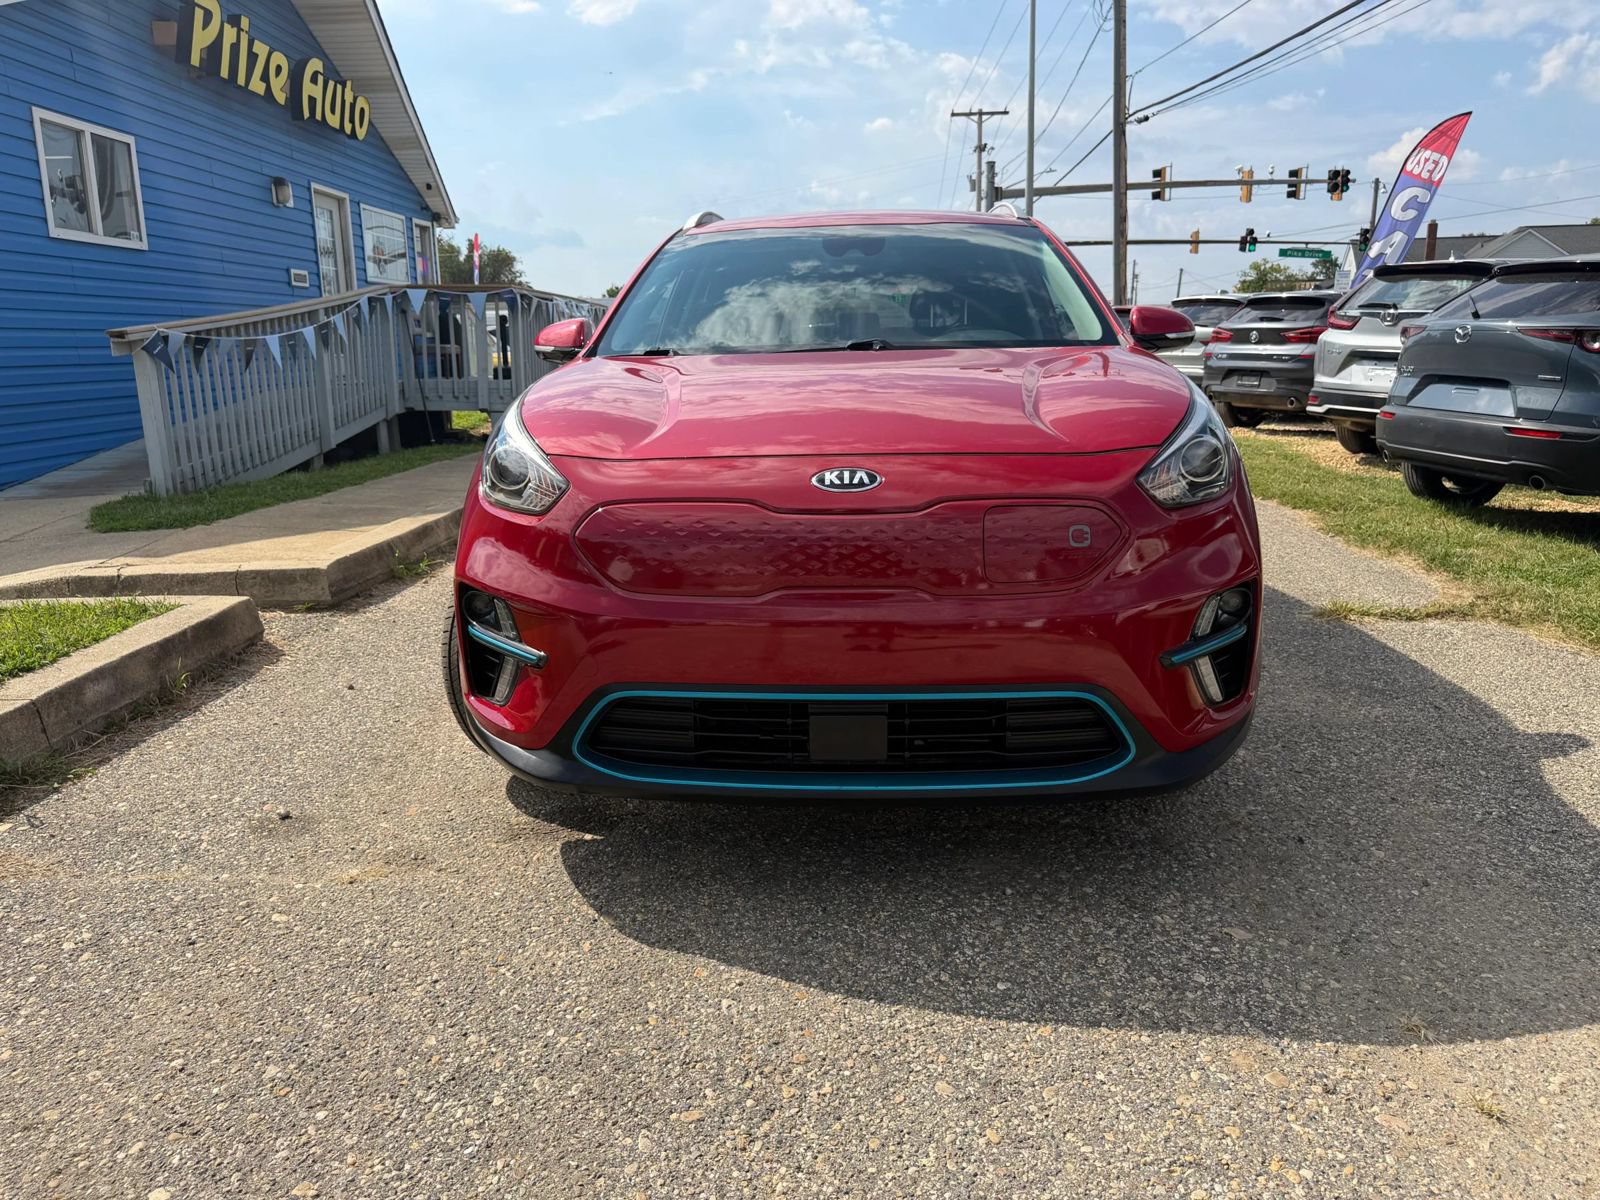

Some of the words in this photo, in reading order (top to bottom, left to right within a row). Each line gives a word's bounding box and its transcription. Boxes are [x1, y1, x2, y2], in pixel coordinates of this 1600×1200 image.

[190, 0, 290, 106] Prize
[302, 57, 370, 141] Auto
[1405, 149, 1448, 182] USED
[1304, 250, 1323, 258] Drive
[824, 470, 871, 485] KIA
